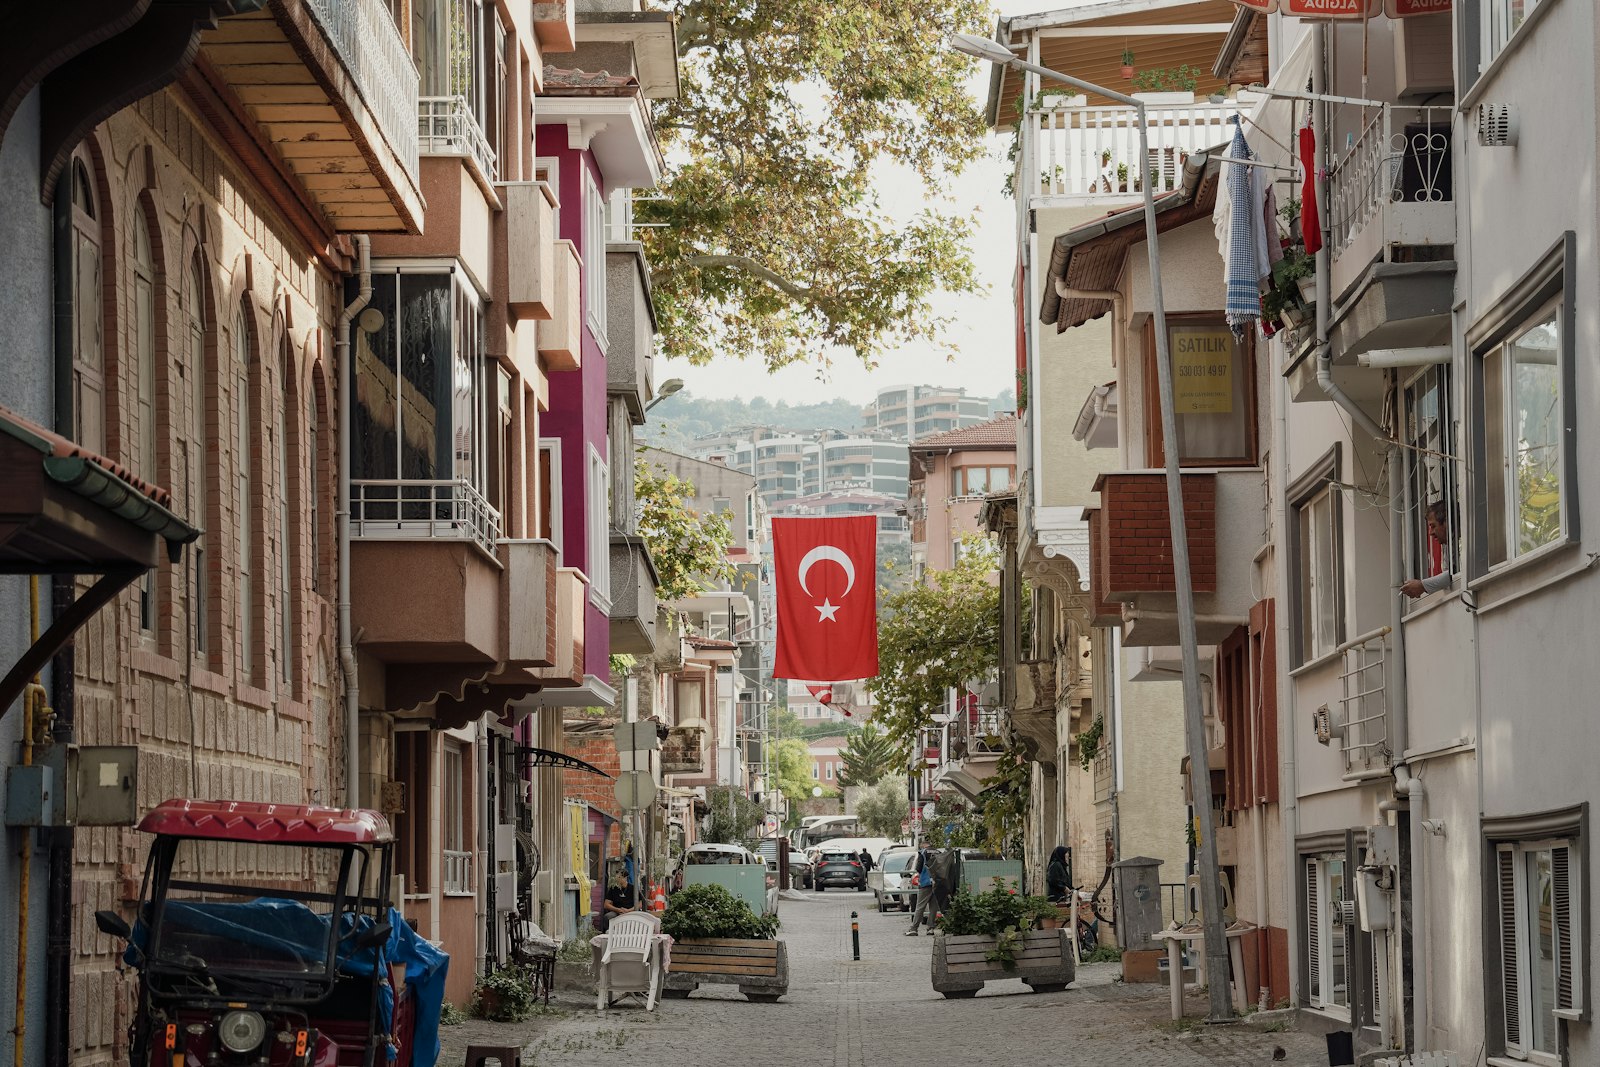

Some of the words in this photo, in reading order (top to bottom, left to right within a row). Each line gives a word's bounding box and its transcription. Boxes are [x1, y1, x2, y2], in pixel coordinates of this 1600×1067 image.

[1178, 337, 1226, 352] SATILIK
[1179, 365, 1192, 377] 530
[1208, 364, 1217, 377] 49
[1218, 364, 1227, 376] 97
